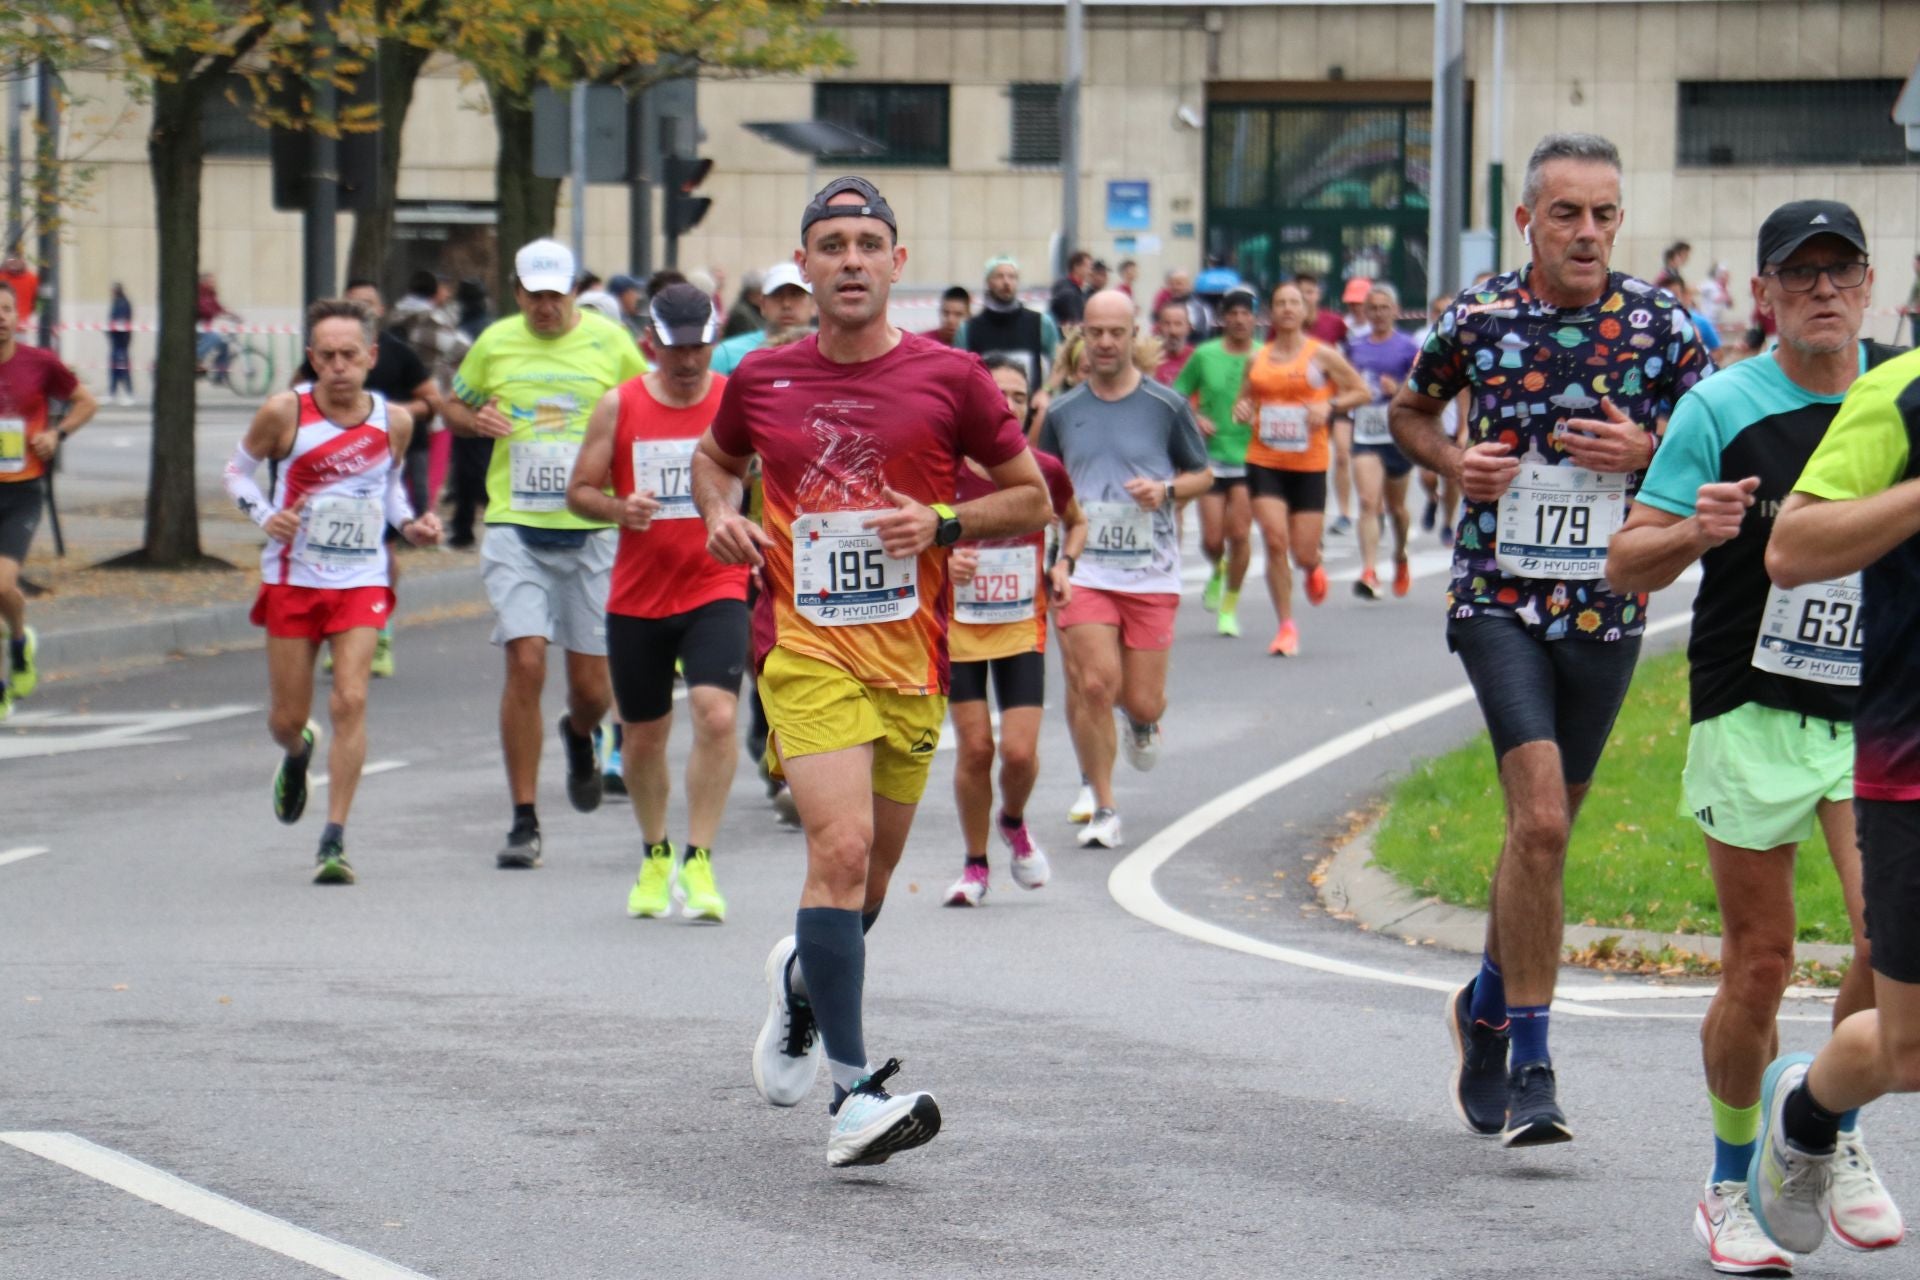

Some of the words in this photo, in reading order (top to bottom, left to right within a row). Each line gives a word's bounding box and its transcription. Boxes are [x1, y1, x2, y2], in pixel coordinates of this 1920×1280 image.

[526, 466, 566, 492] 466
[1531, 492, 1571, 503] FORREST
[1575, 494, 1598, 503] GUMP
[326, 521, 364, 547] 224
[1097, 525, 1137, 550] 494
[1535, 504, 1590, 546] 179
[838, 539, 873, 549] DANIEL
[828, 549, 885, 592] 195
[1543, 560, 1600, 572] HYUNDAI
[974, 573, 1019, 602] 929
[842, 602, 899, 617] HYUNDAI
